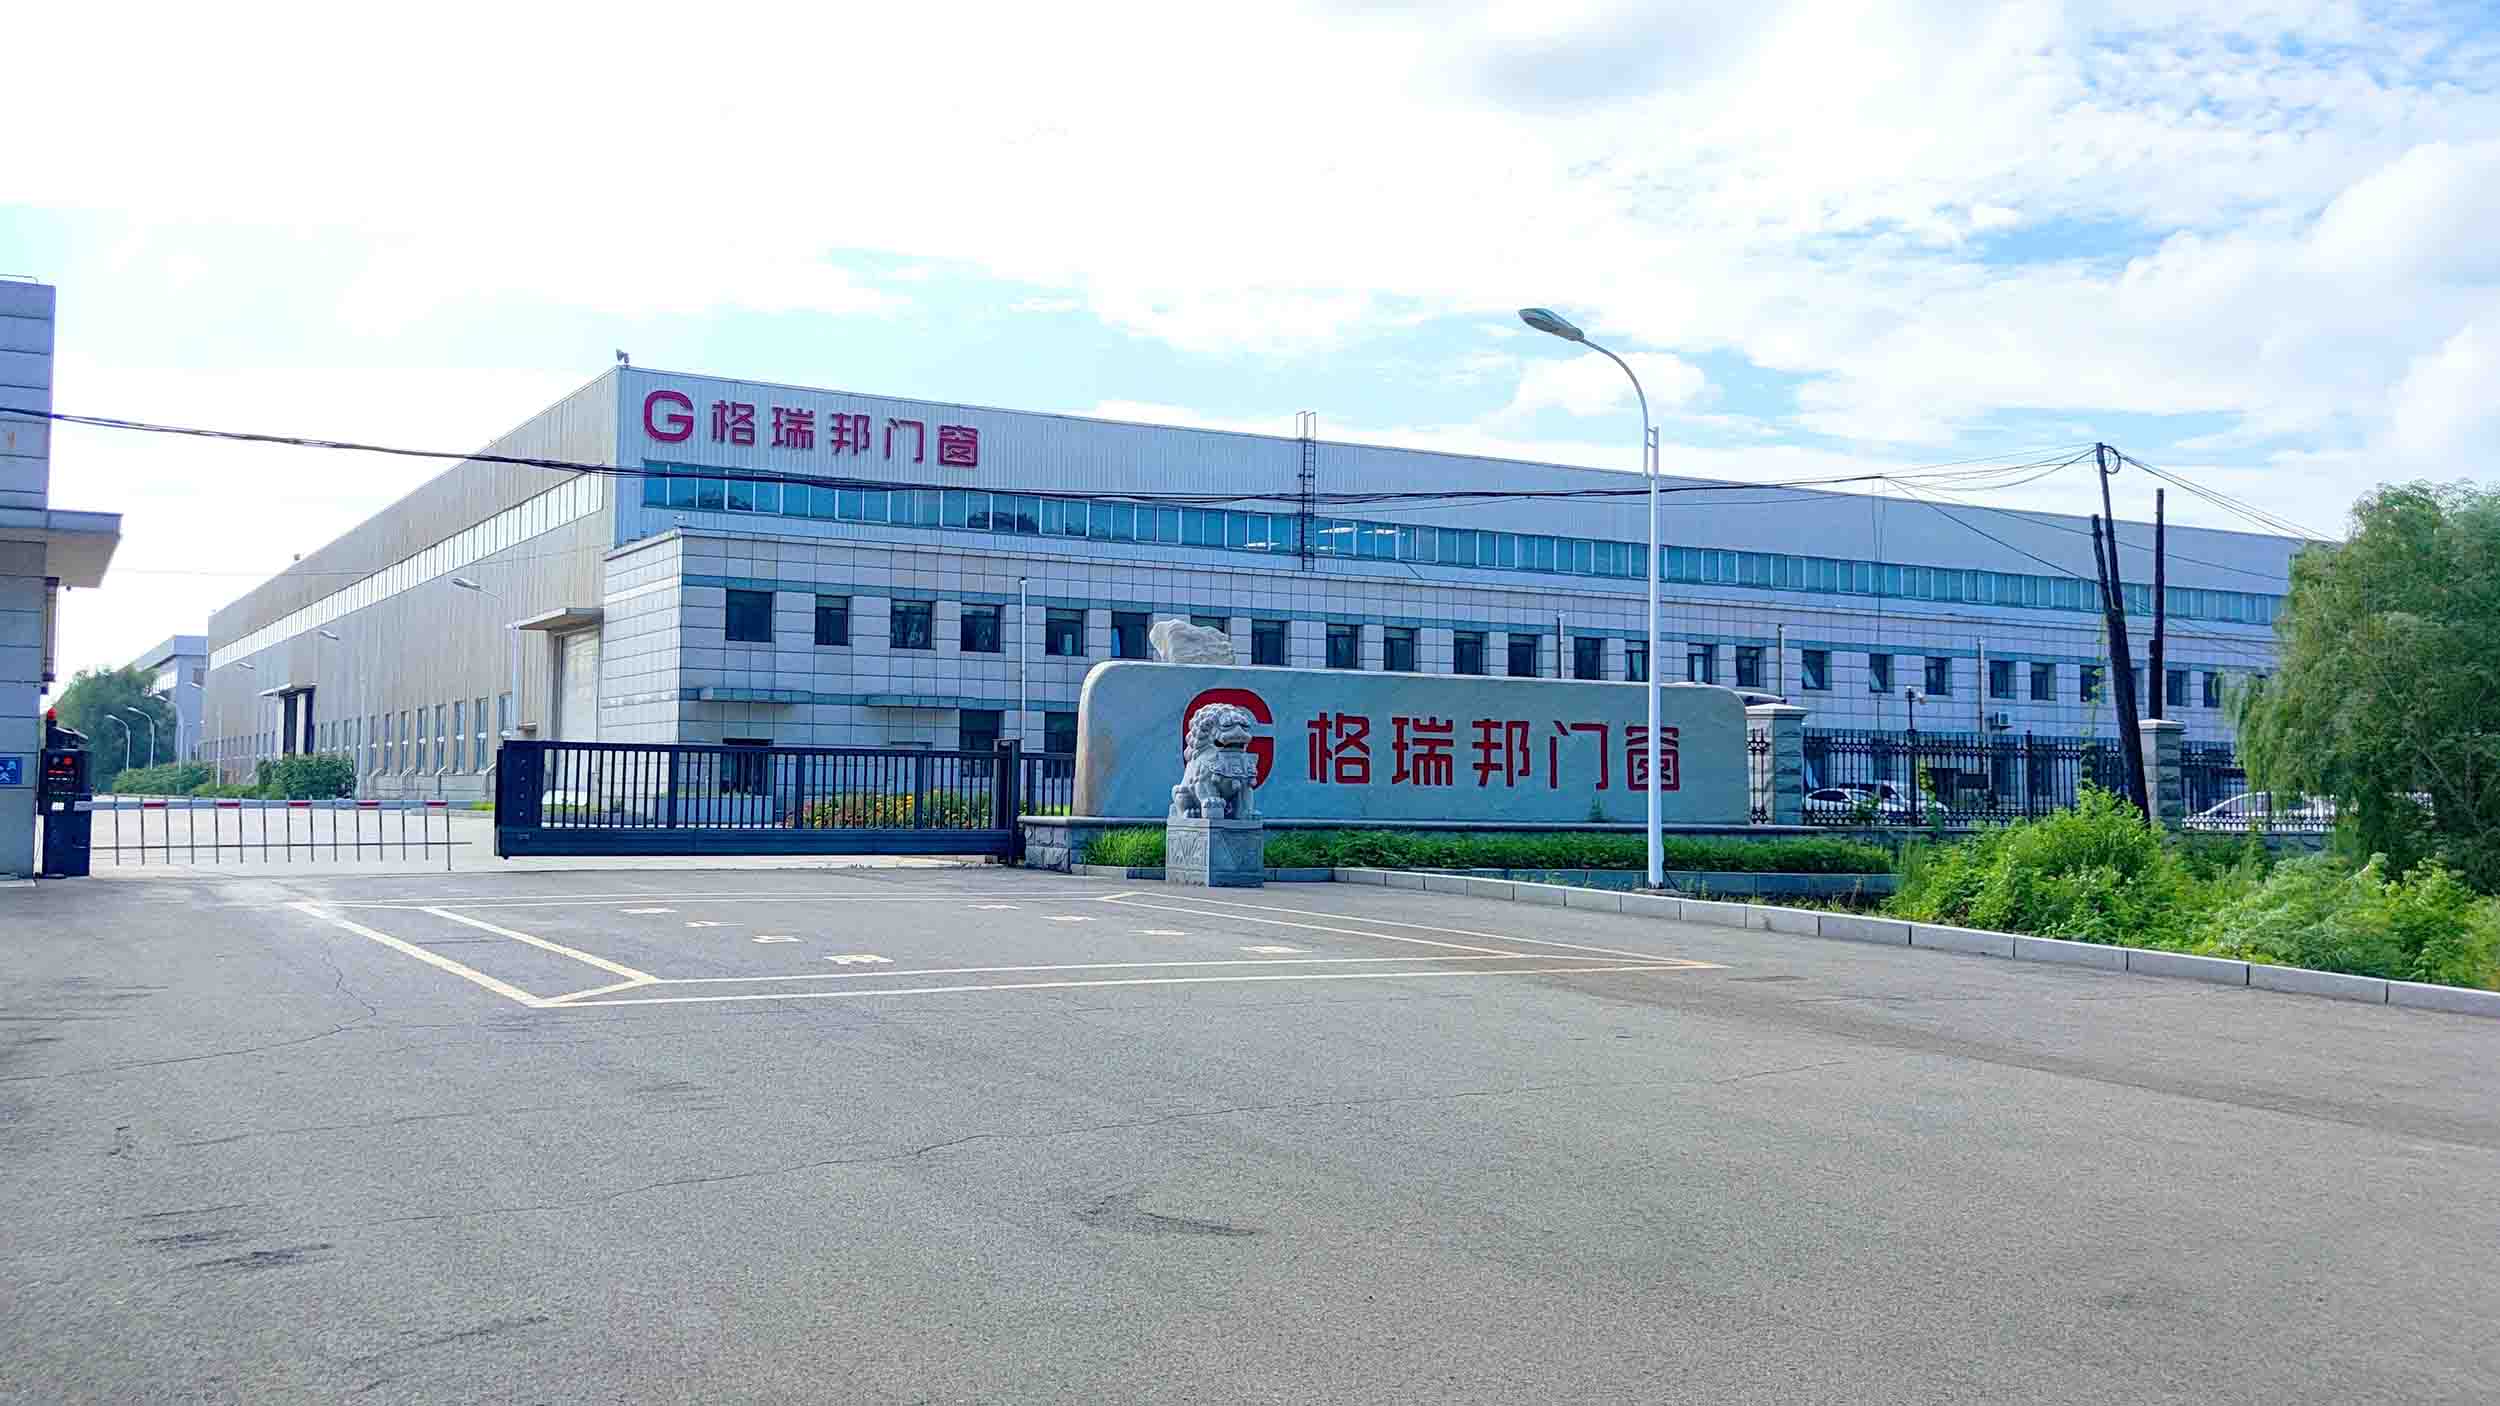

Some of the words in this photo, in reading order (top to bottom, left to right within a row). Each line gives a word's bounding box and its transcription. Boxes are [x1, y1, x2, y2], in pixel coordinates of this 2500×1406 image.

[643, 390, 694, 443] G
[711, 400, 978, 467] 格瑞邦门窗
[1308, 711, 1680, 791] 格瑞邦门窗
